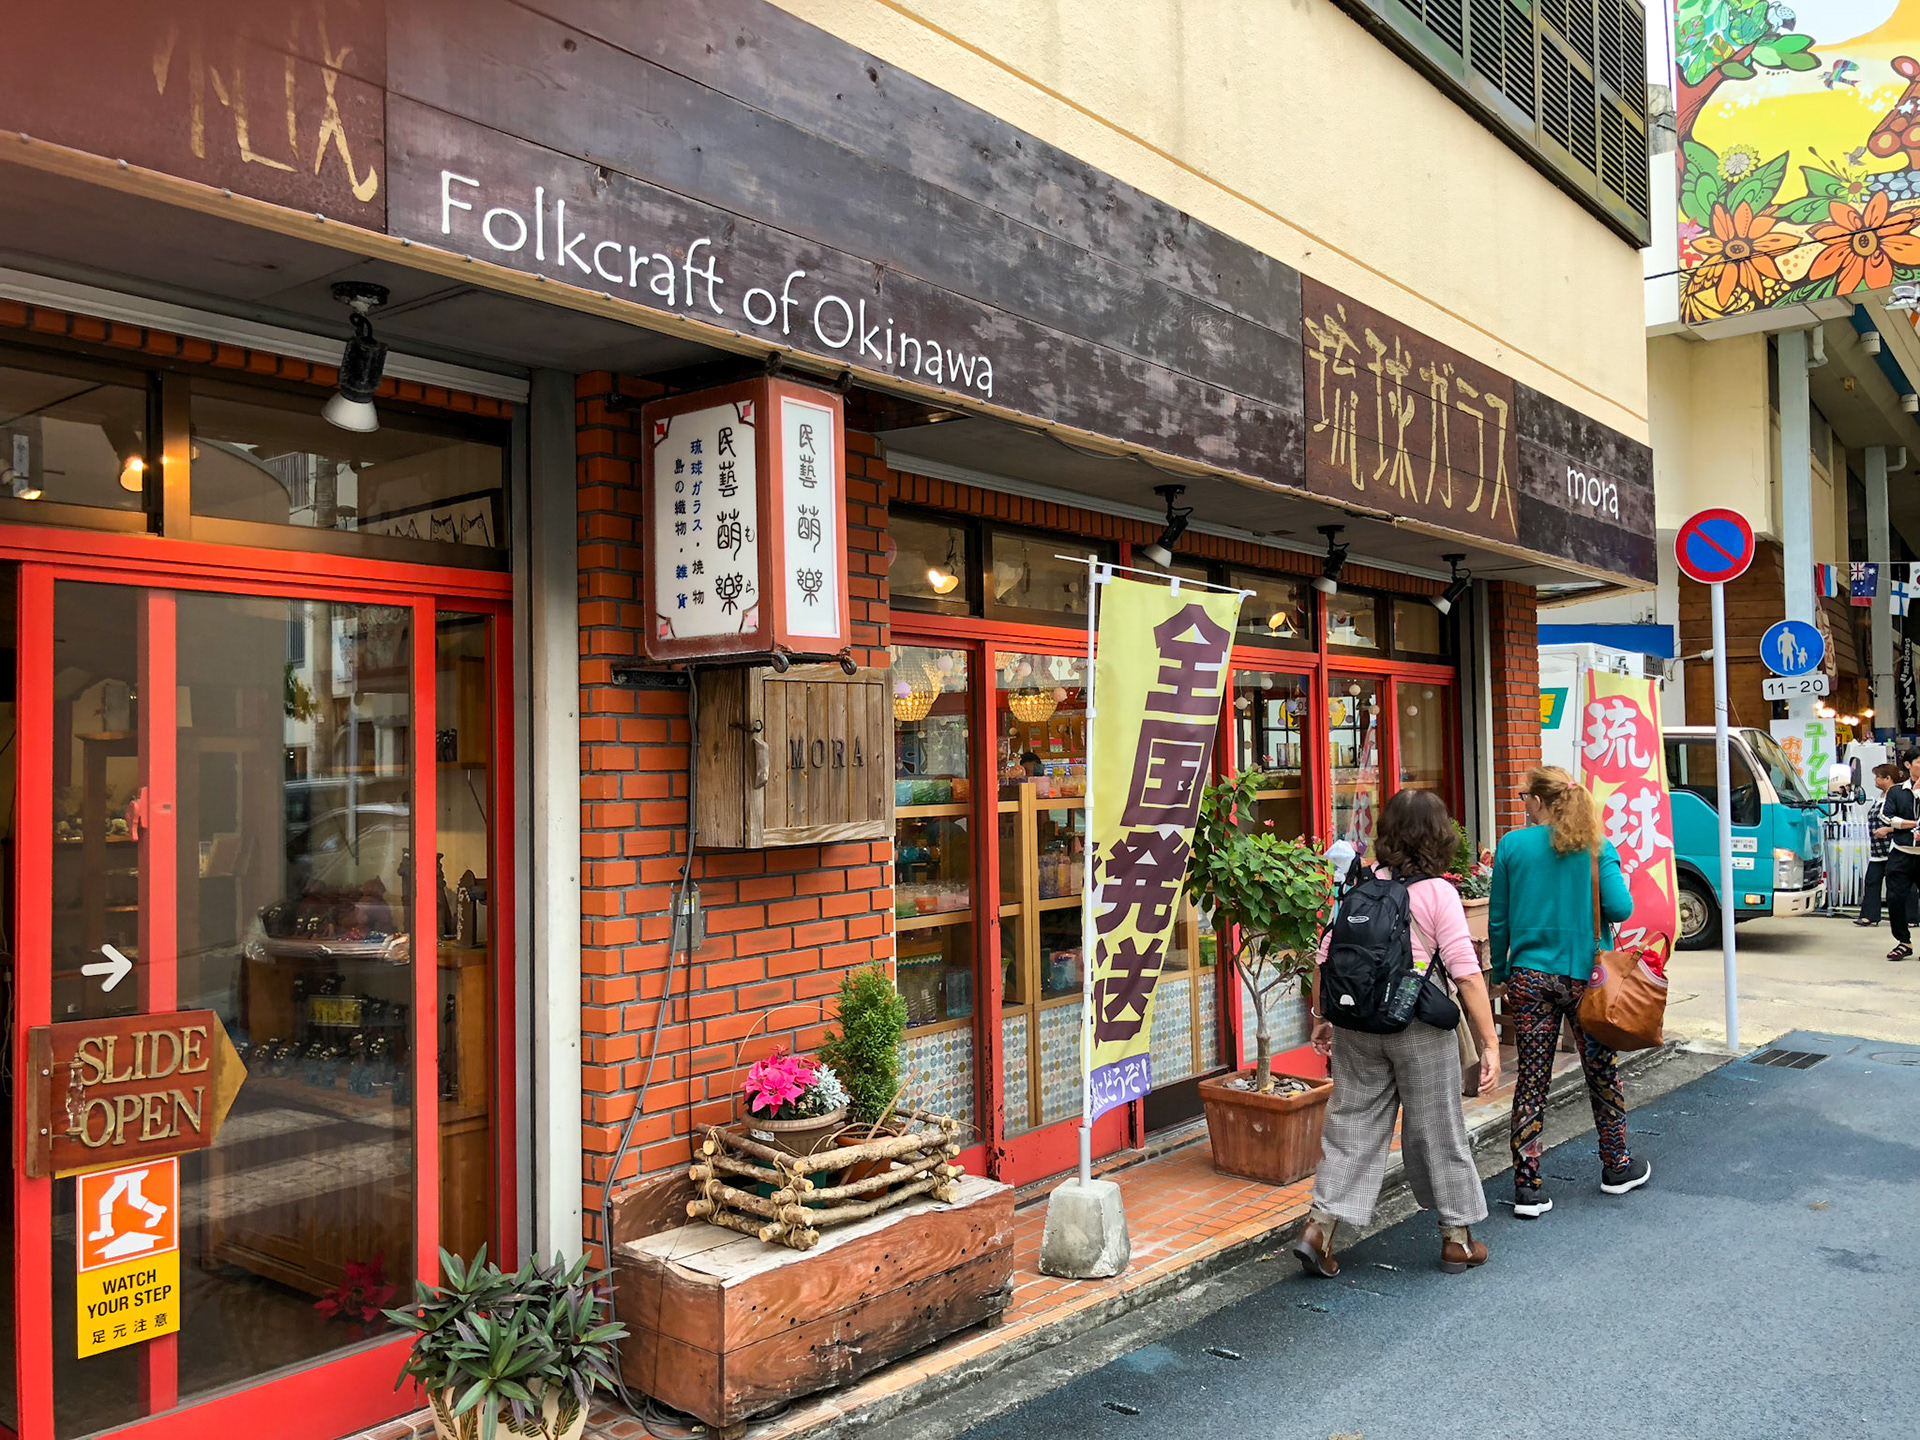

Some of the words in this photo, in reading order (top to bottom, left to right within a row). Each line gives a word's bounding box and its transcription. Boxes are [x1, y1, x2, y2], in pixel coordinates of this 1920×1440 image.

[440, 170, 724, 315] Folkcraft
[743, 270, 806, 336] of
[814, 295, 993, 398] Okinawa
[1304, 303, 1518, 538] 琉球ガラス
[1566, 465, 1619, 520] mora
[1767, 679, 1824, 696] 11-20
[789, 736, 864, 770] MORA
[1092, 603, 1231, 1048] 全国発送
[77, 1025, 210, 1086] SLIDE
[80, 1085, 204, 1149] OPEN
[87, 1293, 129, 1319] YOUR
[134, 1284, 172, 1307] STEP
[102, 1268, 157, 1295] WATCH
[91, 1312, 169, 1345] 足元注意
